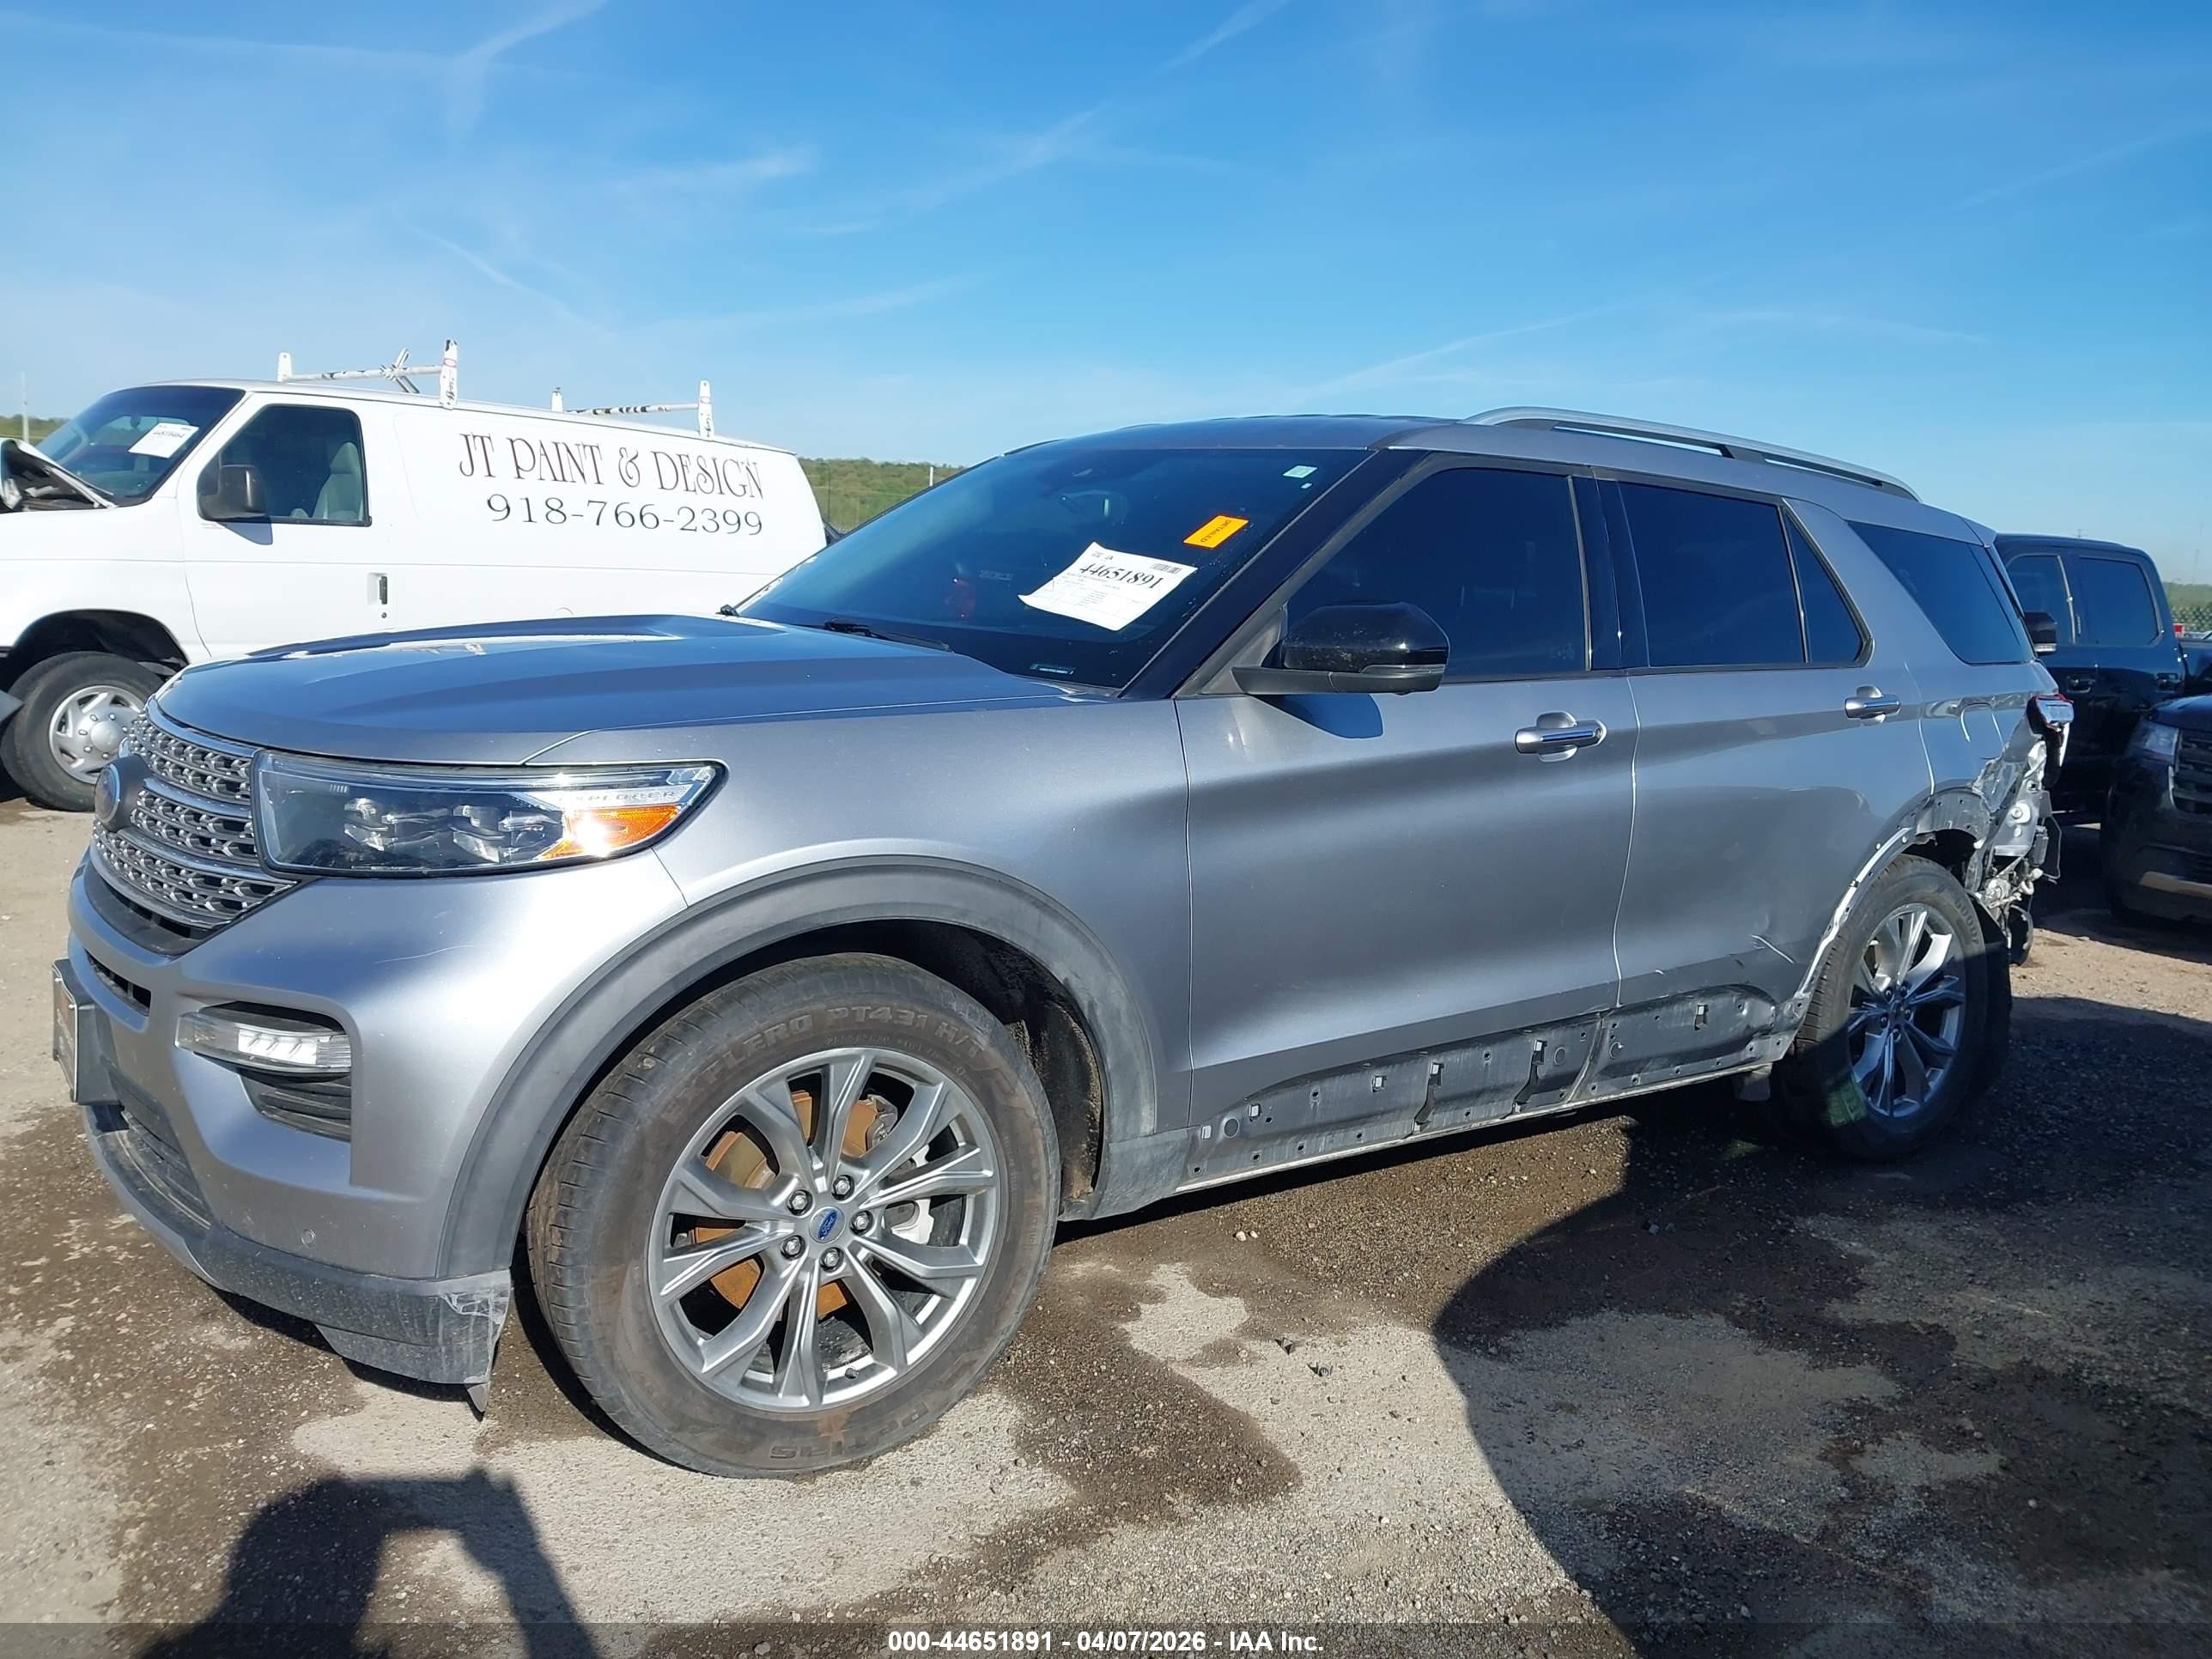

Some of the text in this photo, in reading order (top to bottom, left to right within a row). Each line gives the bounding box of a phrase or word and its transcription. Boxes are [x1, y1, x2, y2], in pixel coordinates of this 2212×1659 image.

[459, 431, 763, 500] JT PAINT & DESIGN
[486, 493, 763, 536] 918-766-2399
[1079, 562, 1164, 589] 44651891
[827, 1006, 928, 1030] PT431
